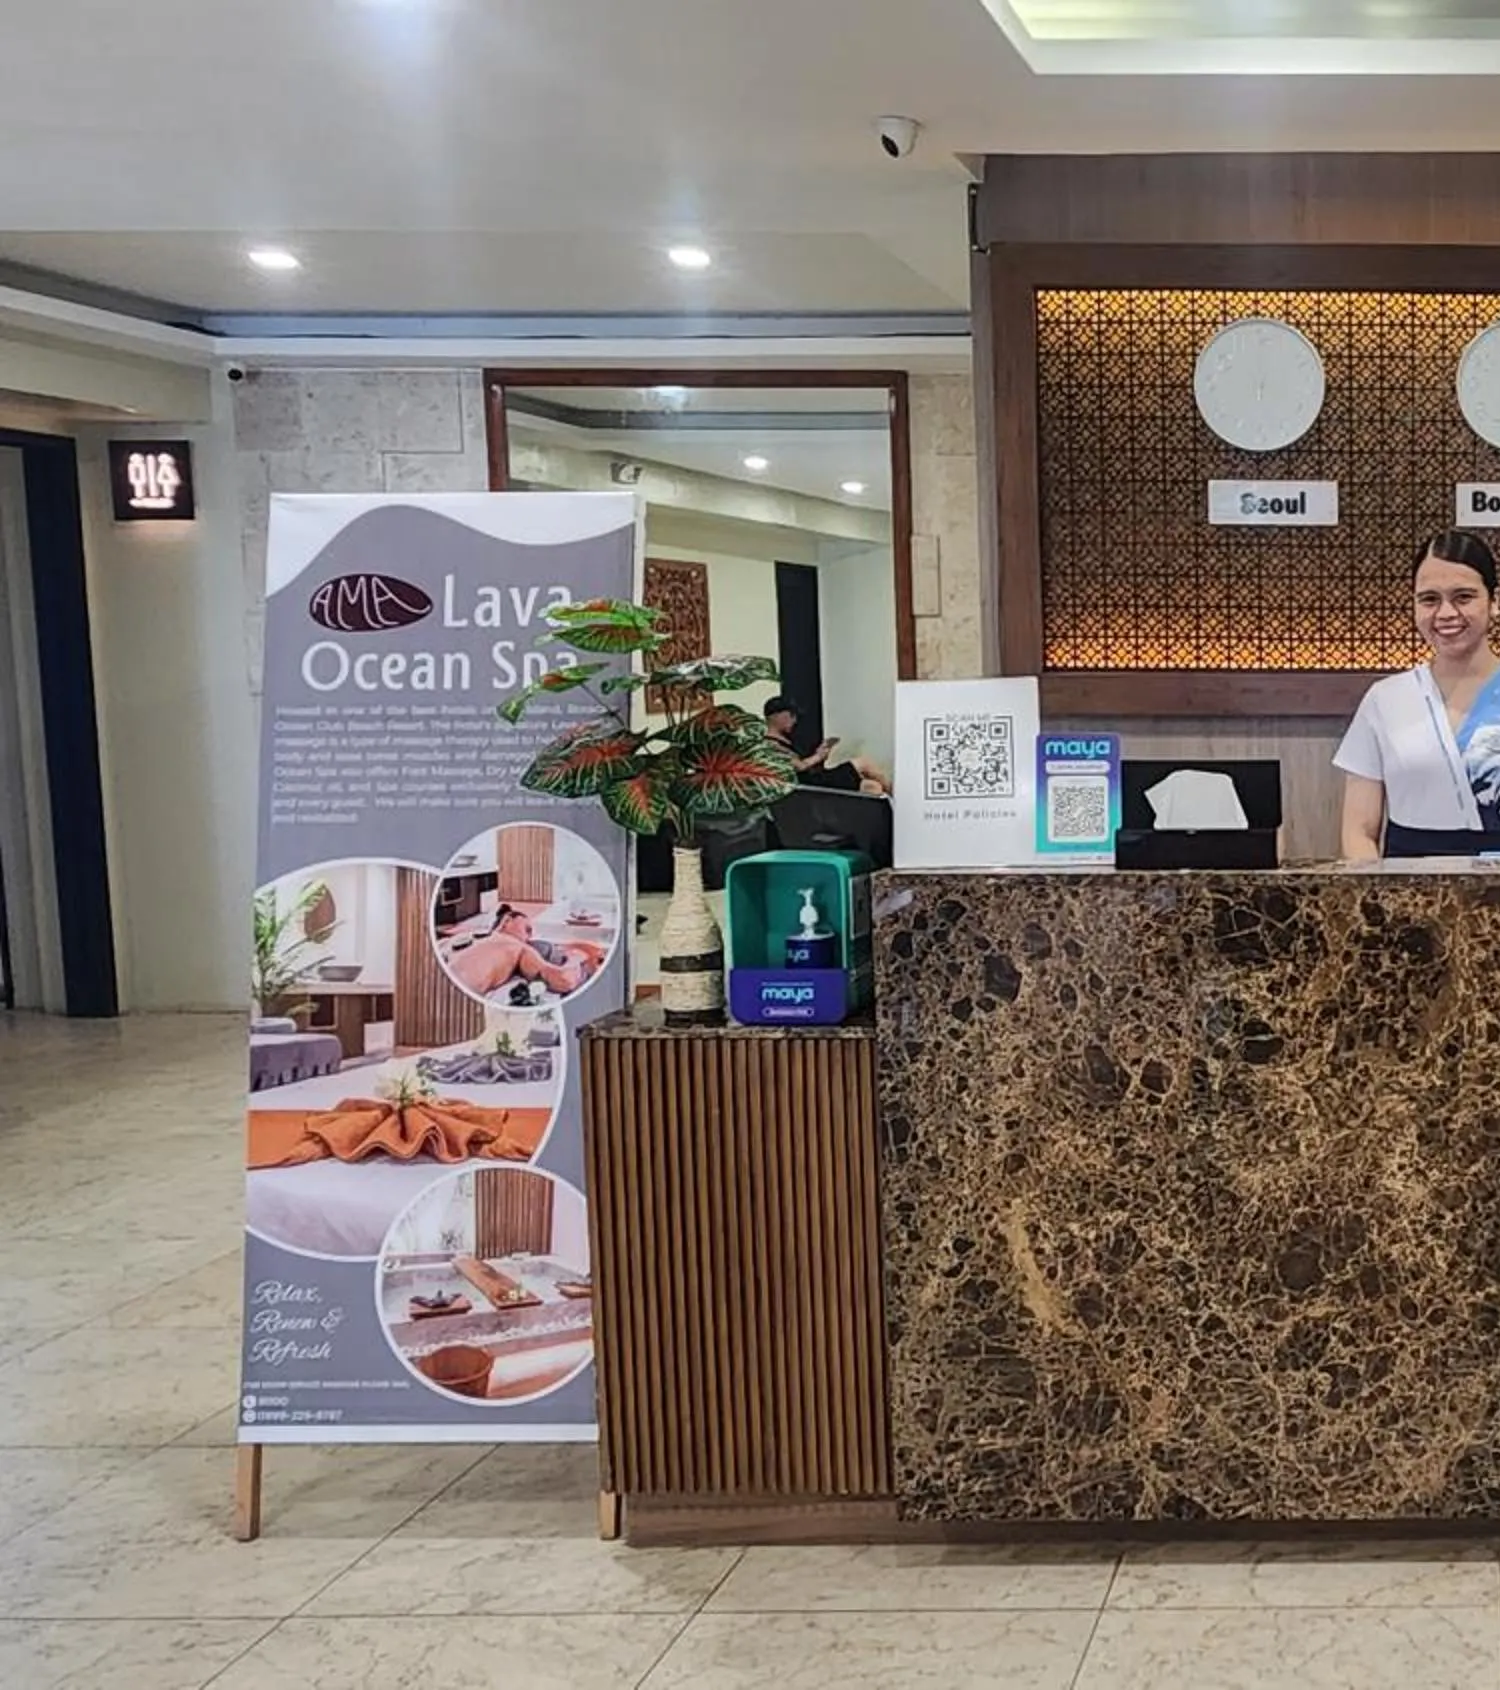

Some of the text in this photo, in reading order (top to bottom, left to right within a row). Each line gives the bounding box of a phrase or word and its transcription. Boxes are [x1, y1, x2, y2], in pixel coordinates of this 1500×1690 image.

[1241, 491, 1306, 515] Seoul
[443, 573, 572, 628] Lava
[302, 641, 470, 691] Ocean
[1045, 741, 1111, 759] maya
[924, 808, 1017, 821] Hotel Policies
[761, 987, 815, 1004] maya
[250, 1279, 322, 1304] Relax,
[250, 1306, 345, 1335] Renew &
[249, 1338, 333, 1367] Refresh
